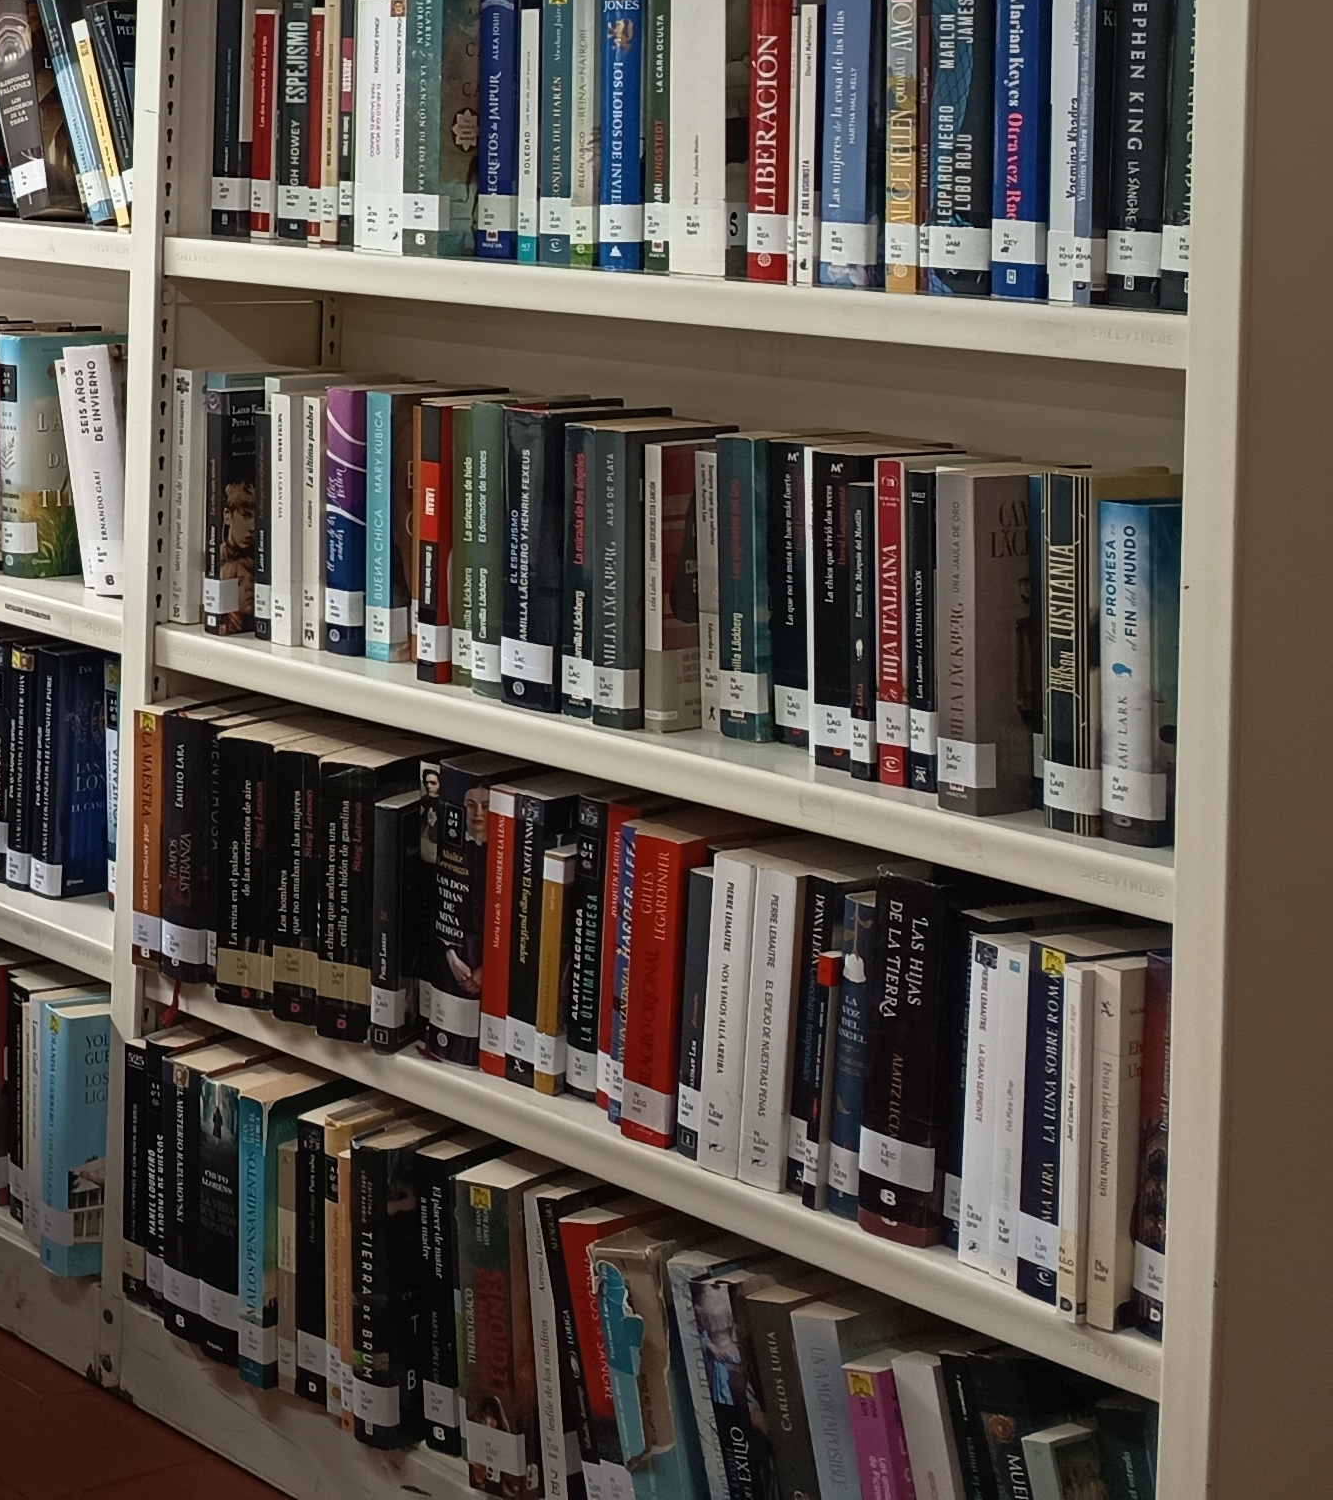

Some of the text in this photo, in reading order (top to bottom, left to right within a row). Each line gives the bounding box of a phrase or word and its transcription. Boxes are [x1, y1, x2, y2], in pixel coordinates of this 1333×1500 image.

[285, 21, 308, 104] ESPEJISMO
[938, 13, 955, 69] MARLON
[1004, 57, 1025, 107] Keyes
[752, 33, 779, 214] LIBERACIÓN
[1127, 91, 1145, 151] KING
[74, 368, 91, 434] SEIS AÑOS
[86, 360, 104, 442] DE INVIERNO
[881, 544, 901, 683] HIJA ITALIANA
[174, 743, 186, 809] EMILIO LARA
[639, 870, 654, 915] GILLES
[654, 851, 670, 942] LEGARDINIER
[879, 899, 904, 1018] DE LA TIERRA
[905, 916, 929, 1006] LAS HIJAS
[767, 1331, 792, 1432] CARLOS LURIA
